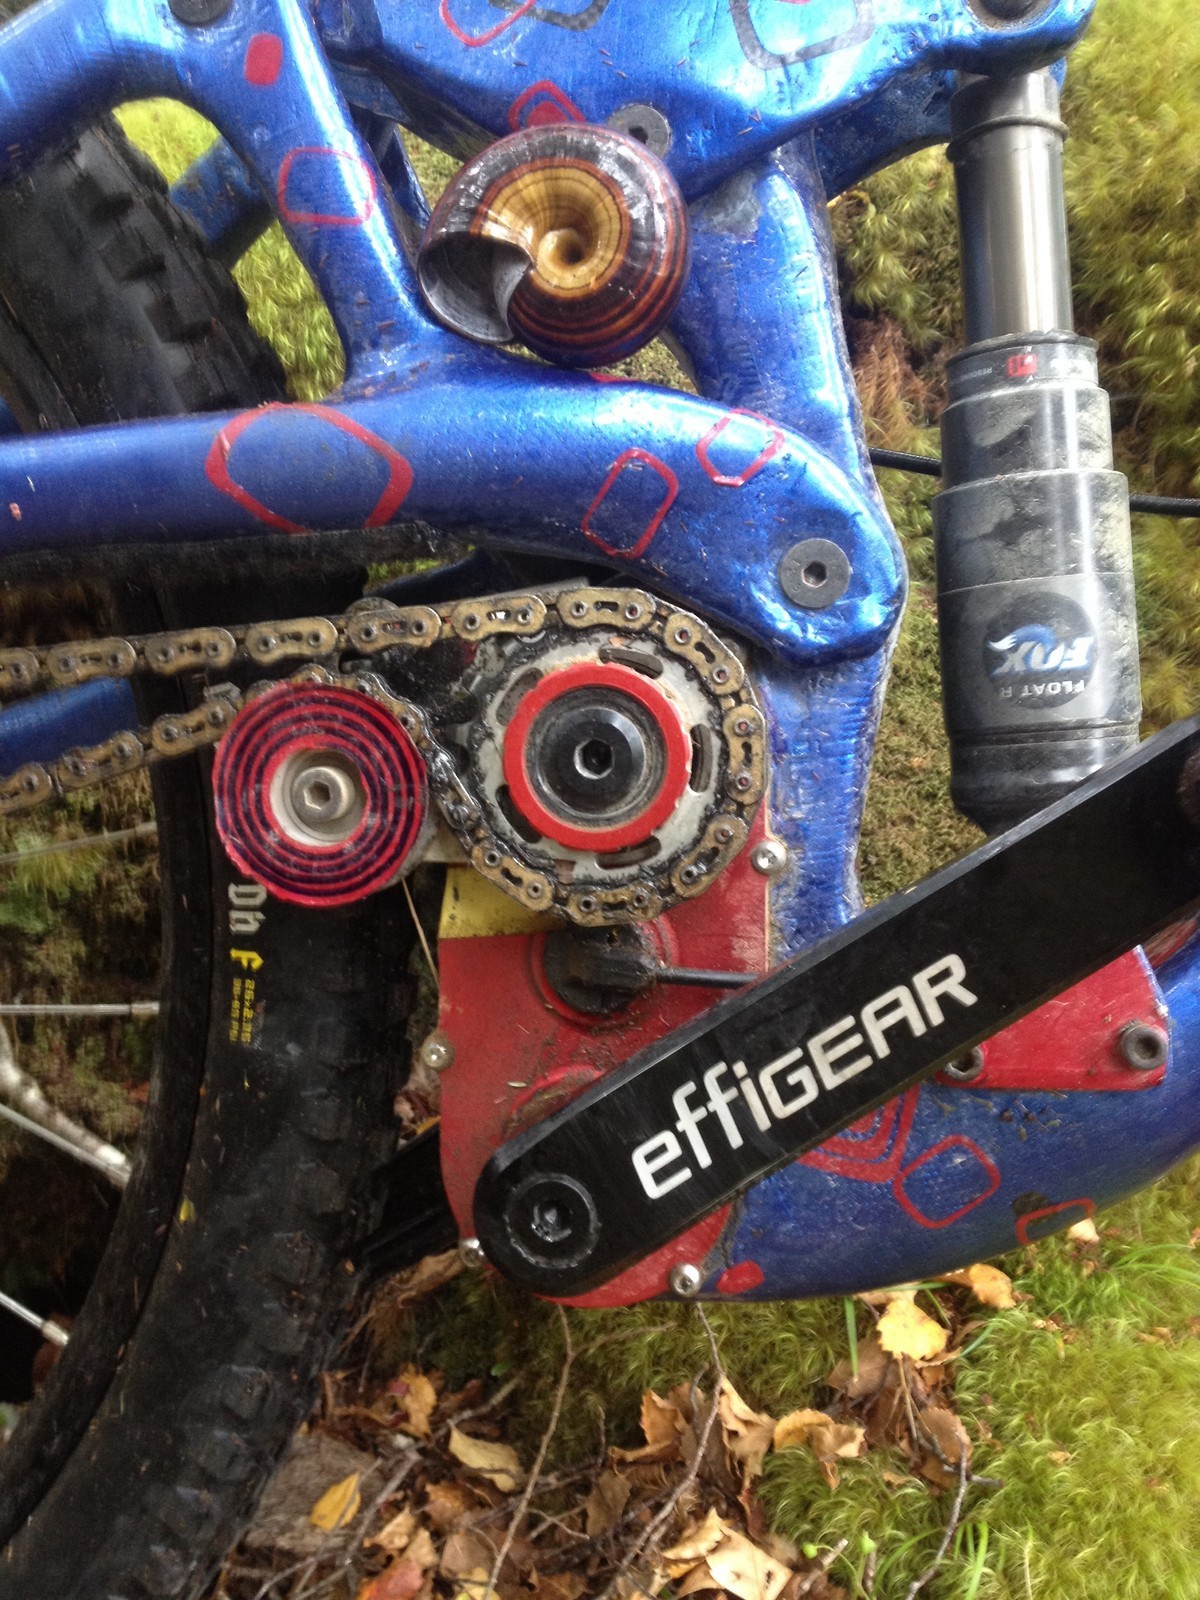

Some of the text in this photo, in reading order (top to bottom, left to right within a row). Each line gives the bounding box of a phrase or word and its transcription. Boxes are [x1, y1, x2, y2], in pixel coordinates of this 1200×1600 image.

[989, 627, 1096, 675] FOX
[1001, 680, 1085, 698] FLOAT R
[631, 953, 978, 1200] effiGEAR
